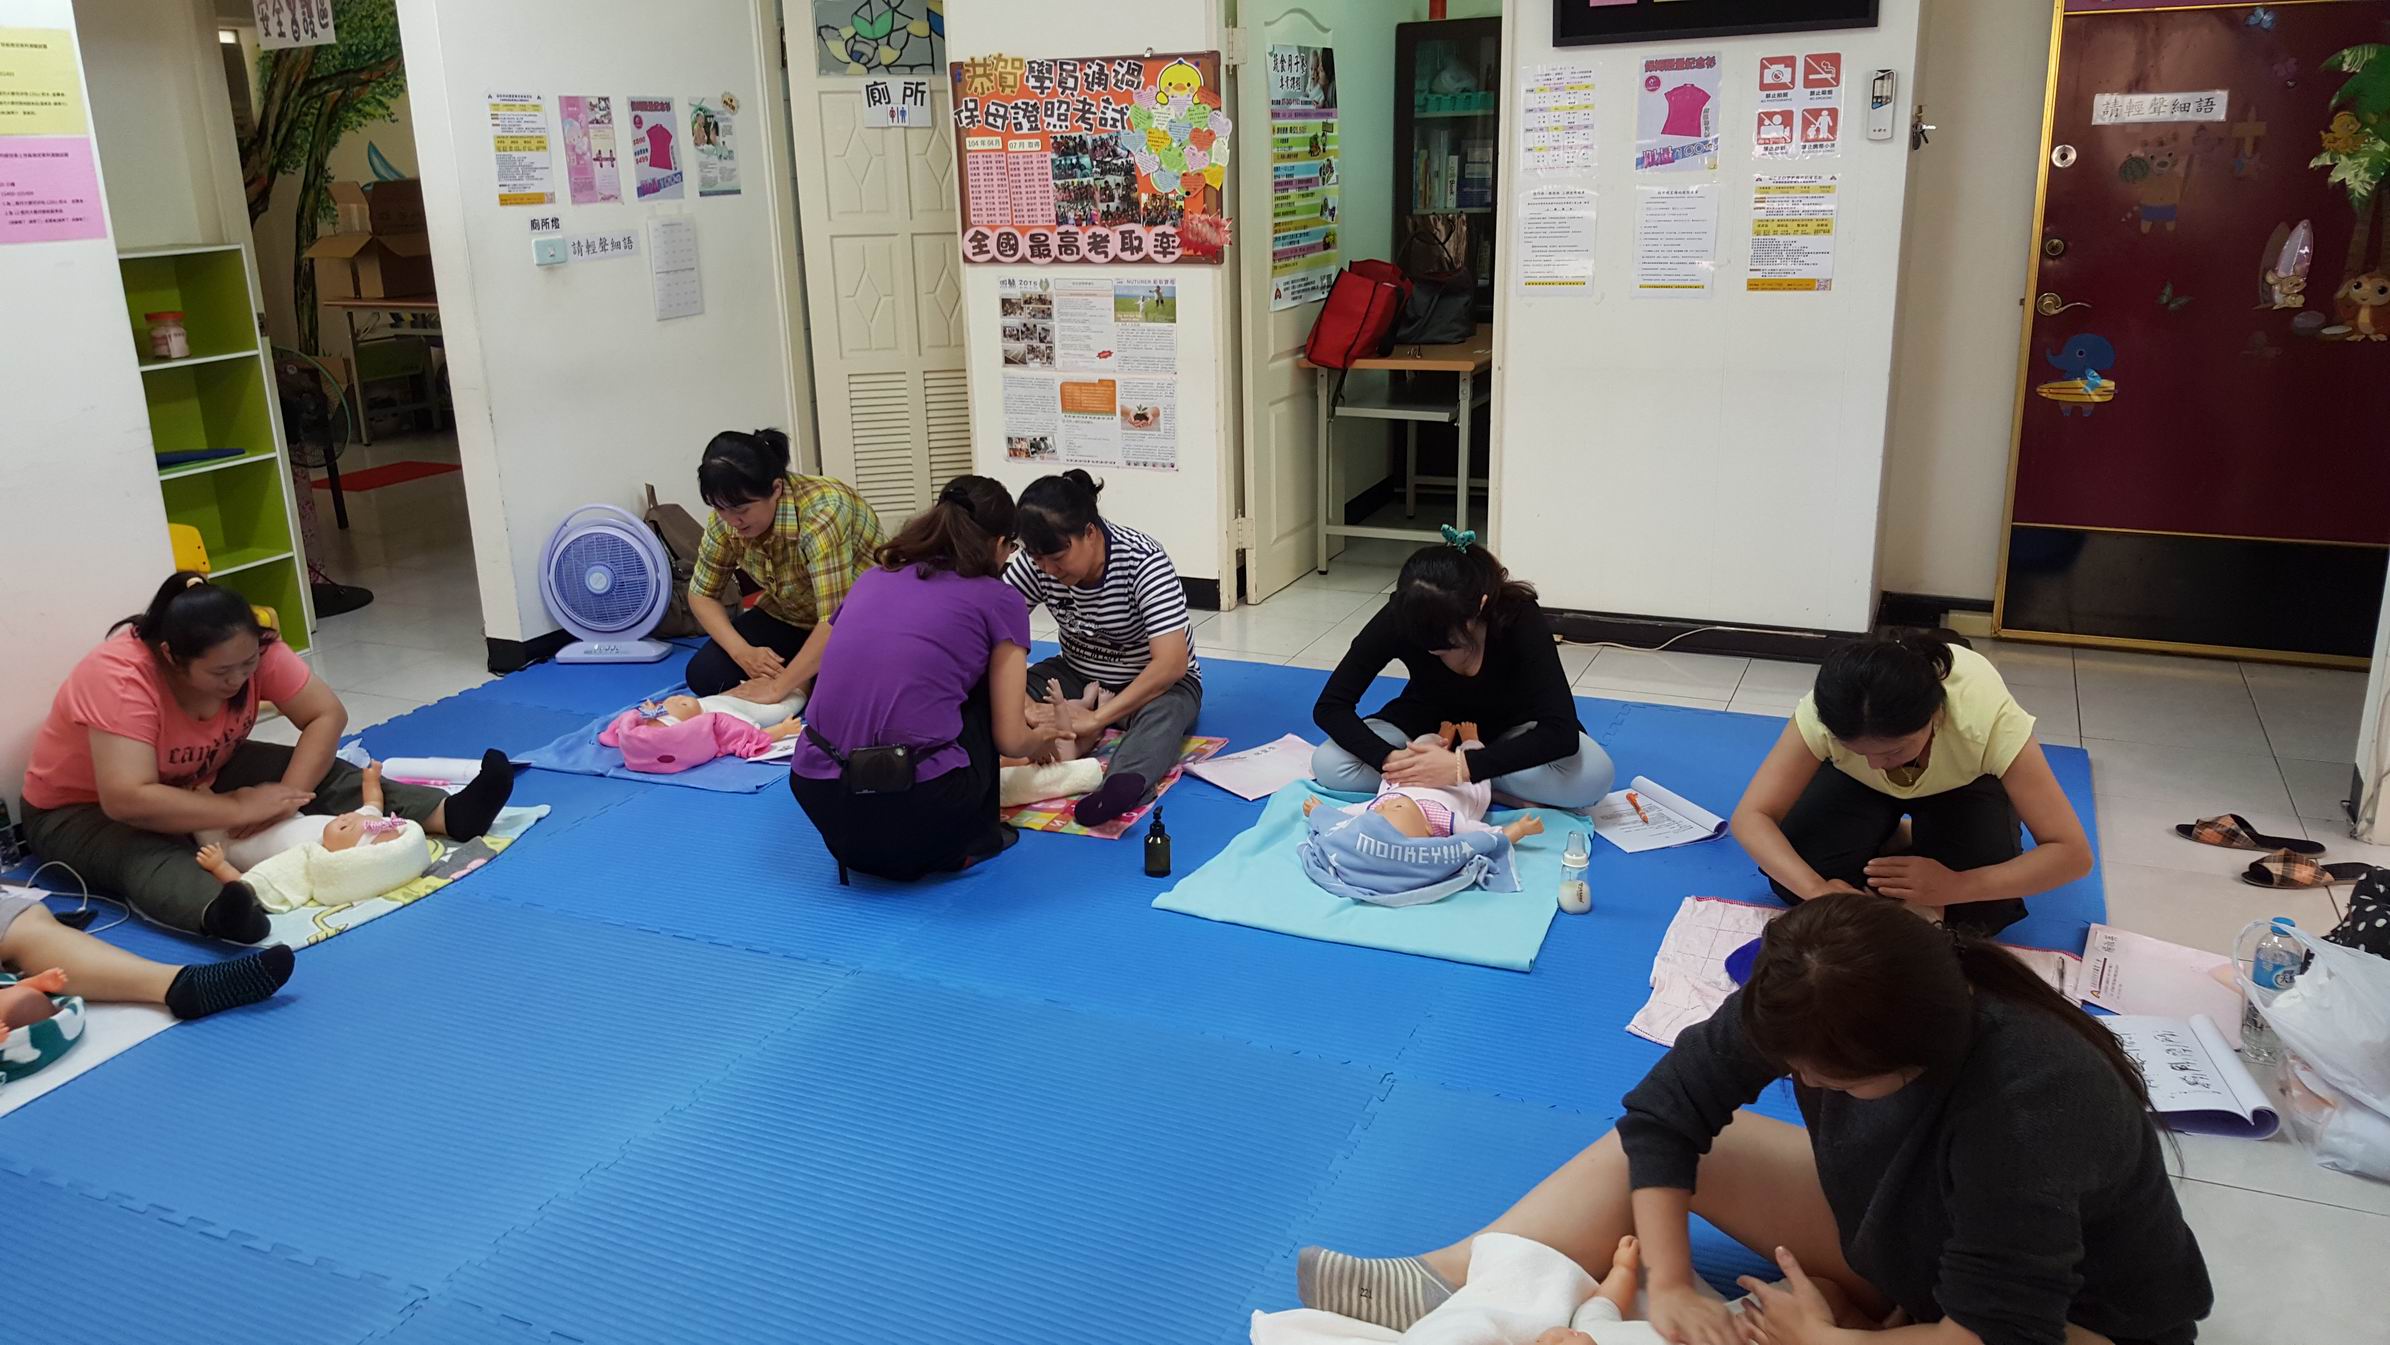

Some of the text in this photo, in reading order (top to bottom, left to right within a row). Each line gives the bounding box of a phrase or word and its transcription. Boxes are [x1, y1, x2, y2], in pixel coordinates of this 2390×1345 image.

[964, 54, 1144, 97] 恭賀學員通過
[866, 81, 926, 107] 廁所
[2102, 97, 2216, 117] 請輕聲細語
[953, 97, 1130, 132] 保母證照考試
[571, 236, 633, 257] 請輕聲細語
[967, 229, 1178, 259] 全國最高考取率
